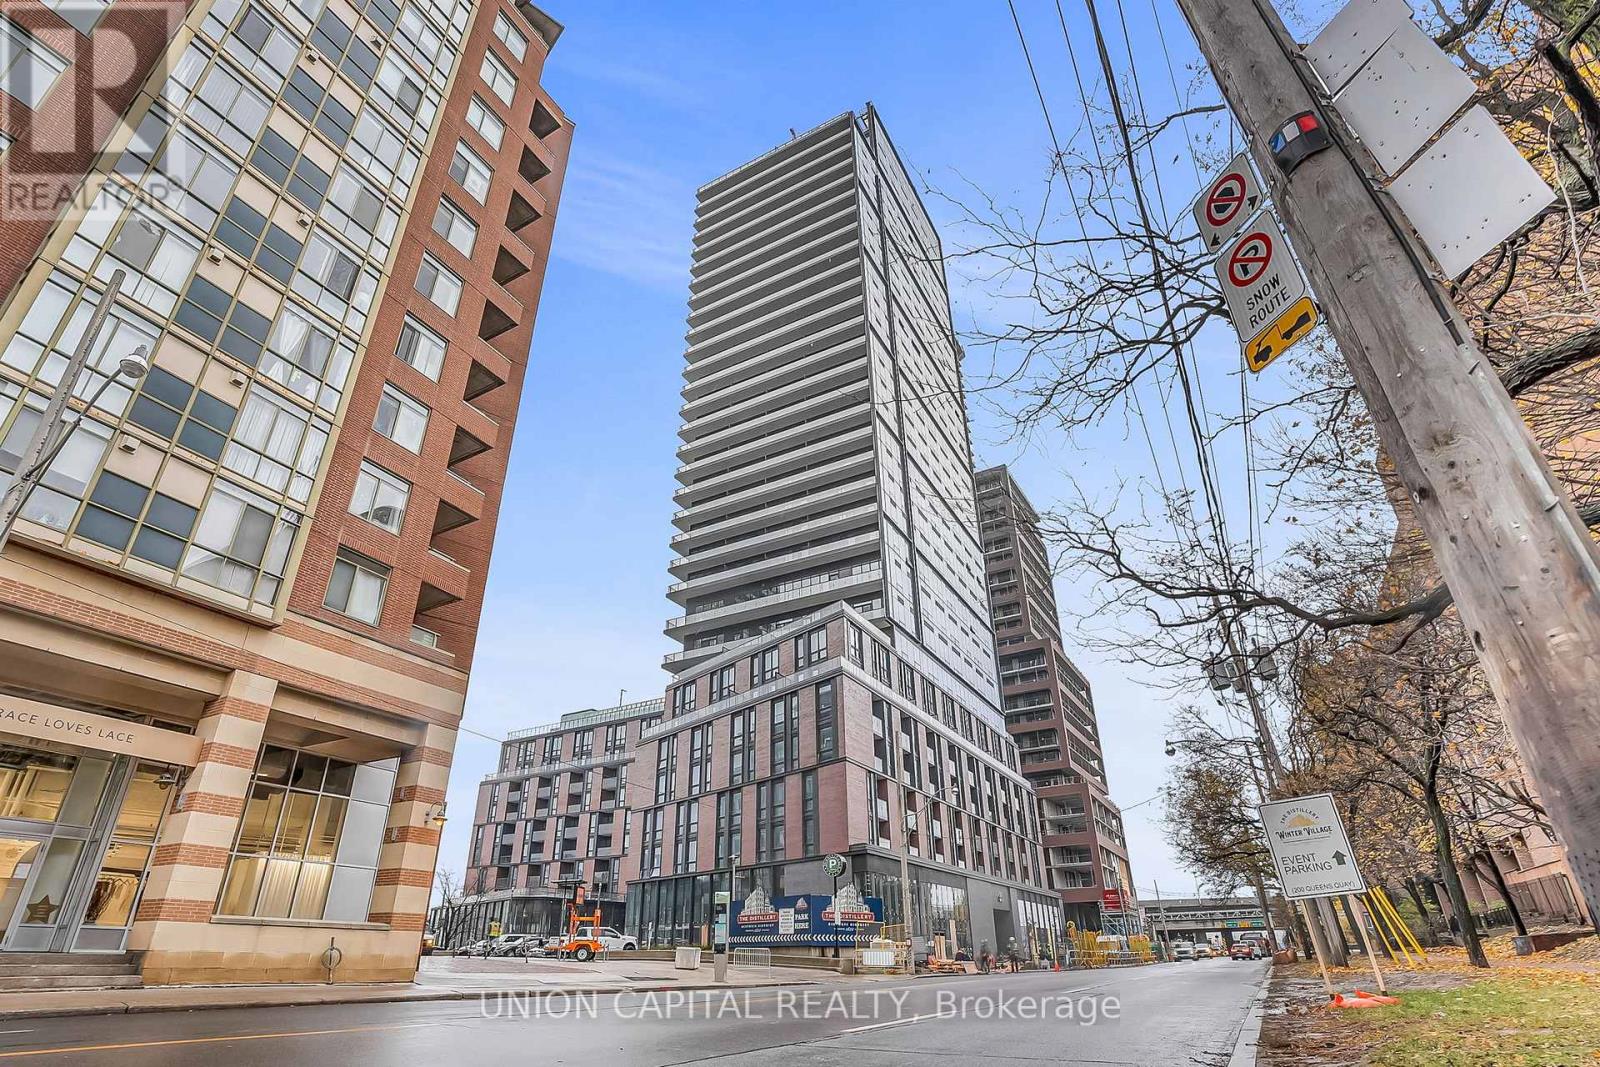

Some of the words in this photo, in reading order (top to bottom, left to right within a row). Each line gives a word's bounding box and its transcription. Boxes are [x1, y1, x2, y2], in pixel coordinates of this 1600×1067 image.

[1246, 273, 1281, 311] SNOW
[1249, 286, 1291, 329] ROUTE
[44, 718, 92, 735] LOVES
[98, 729, 135, 744] LACE
[1275, 829, 1303, 840] WINTER
[1303, 826, 1333, 836] VILLAGE
[829, 859, 837, 869] P
[1281, 853, 1316, 866] EVENT
[1284, 861, 1333, 875] PARKING
[1305, 883, 1333, 892] QUEENS
